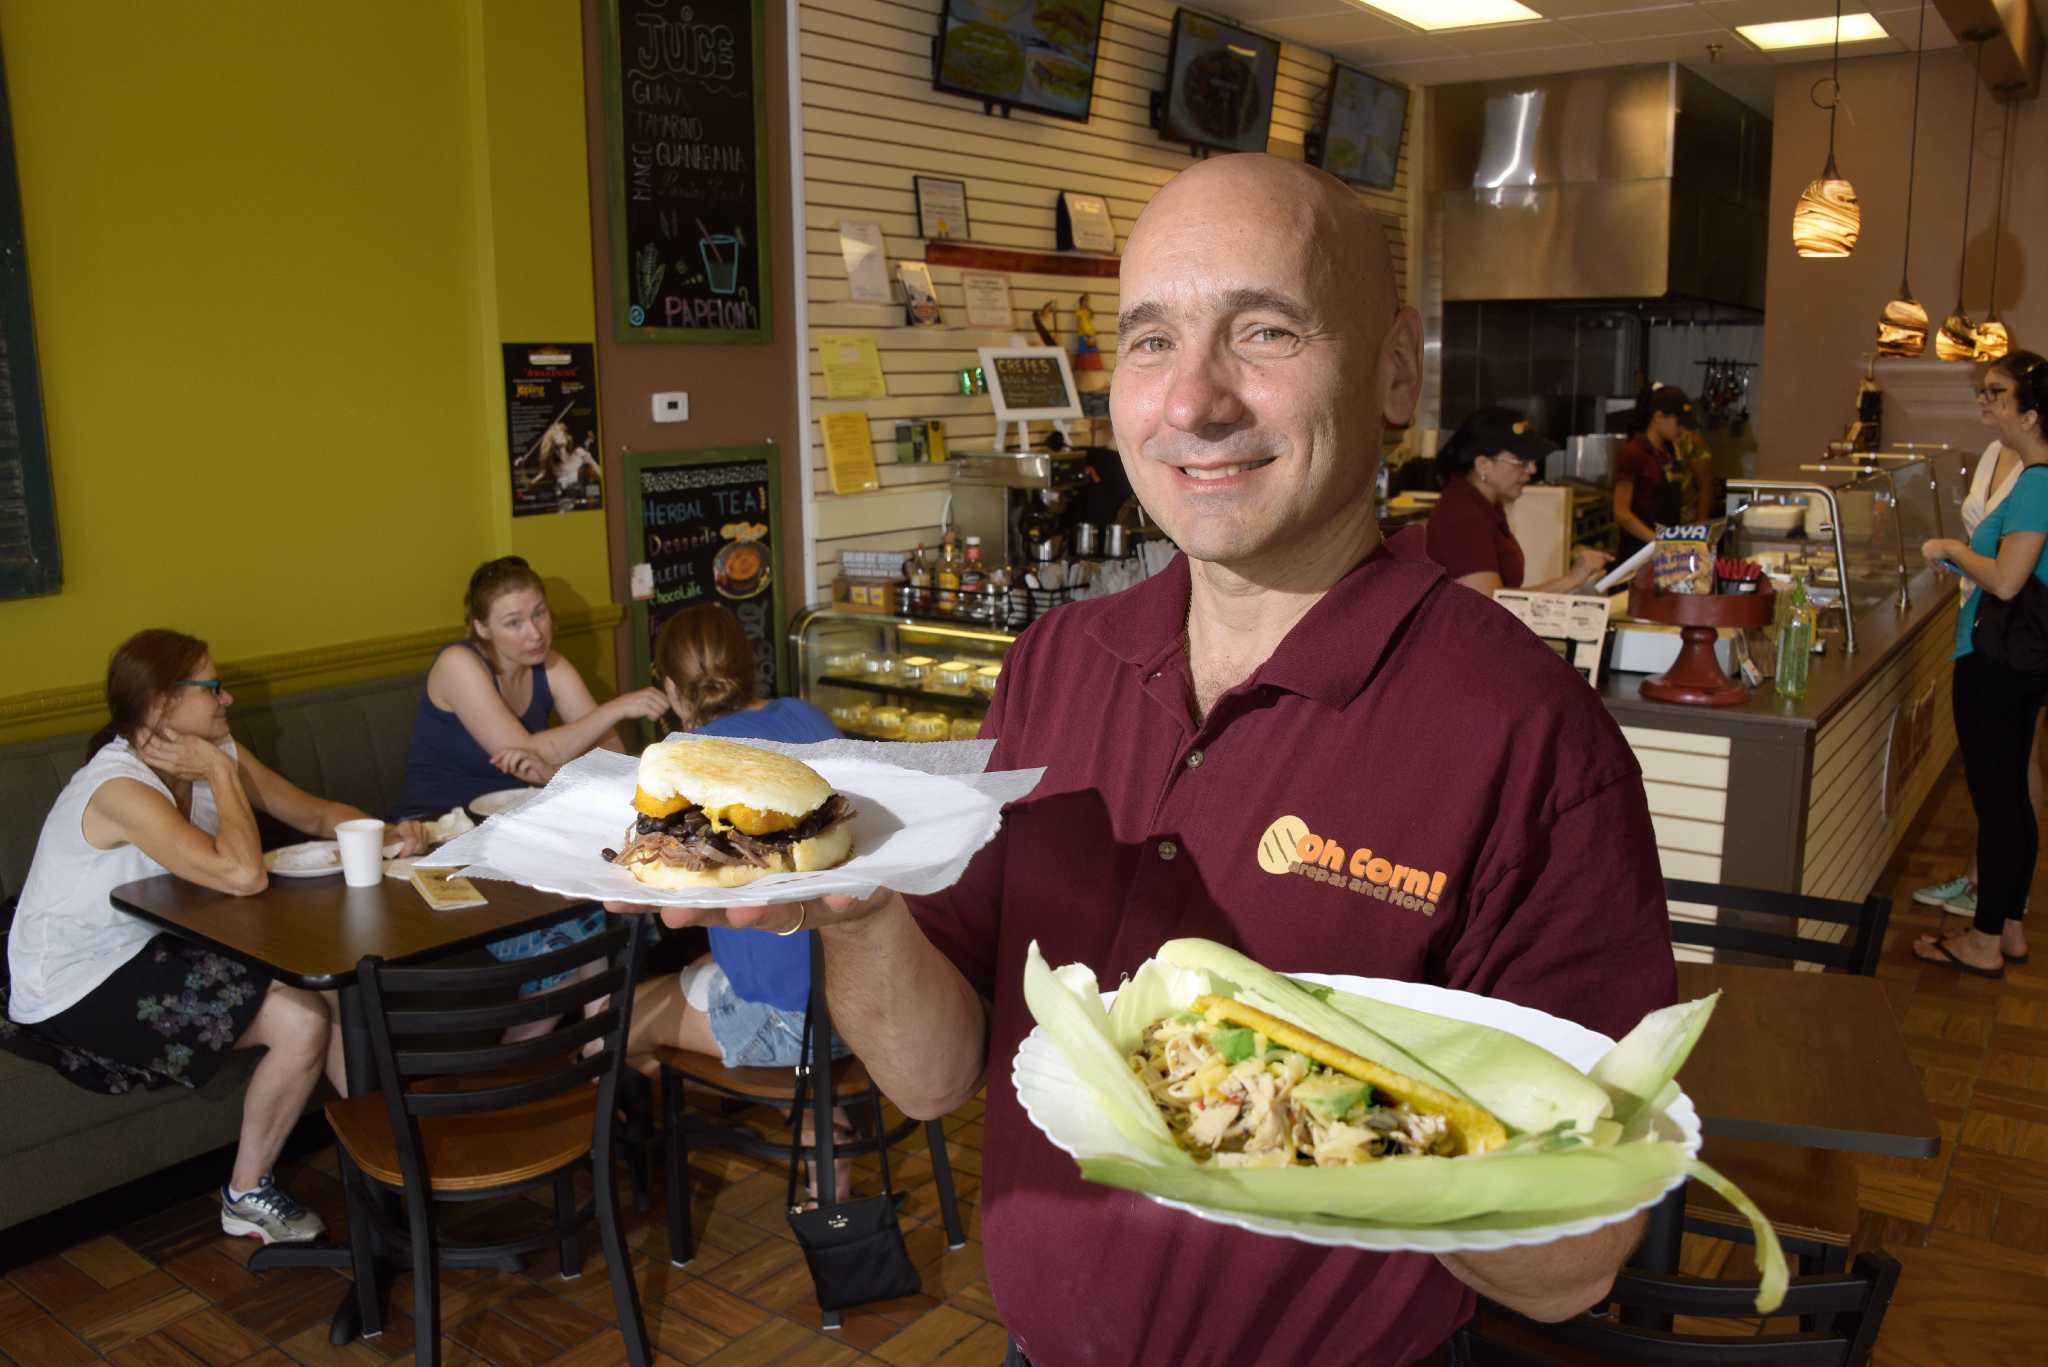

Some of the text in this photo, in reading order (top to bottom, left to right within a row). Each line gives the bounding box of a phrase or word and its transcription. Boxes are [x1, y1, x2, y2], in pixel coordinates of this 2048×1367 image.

[643, 486, 766, 527] HERBAL TEA!
[1296, 834, 1346, 873] Oh
